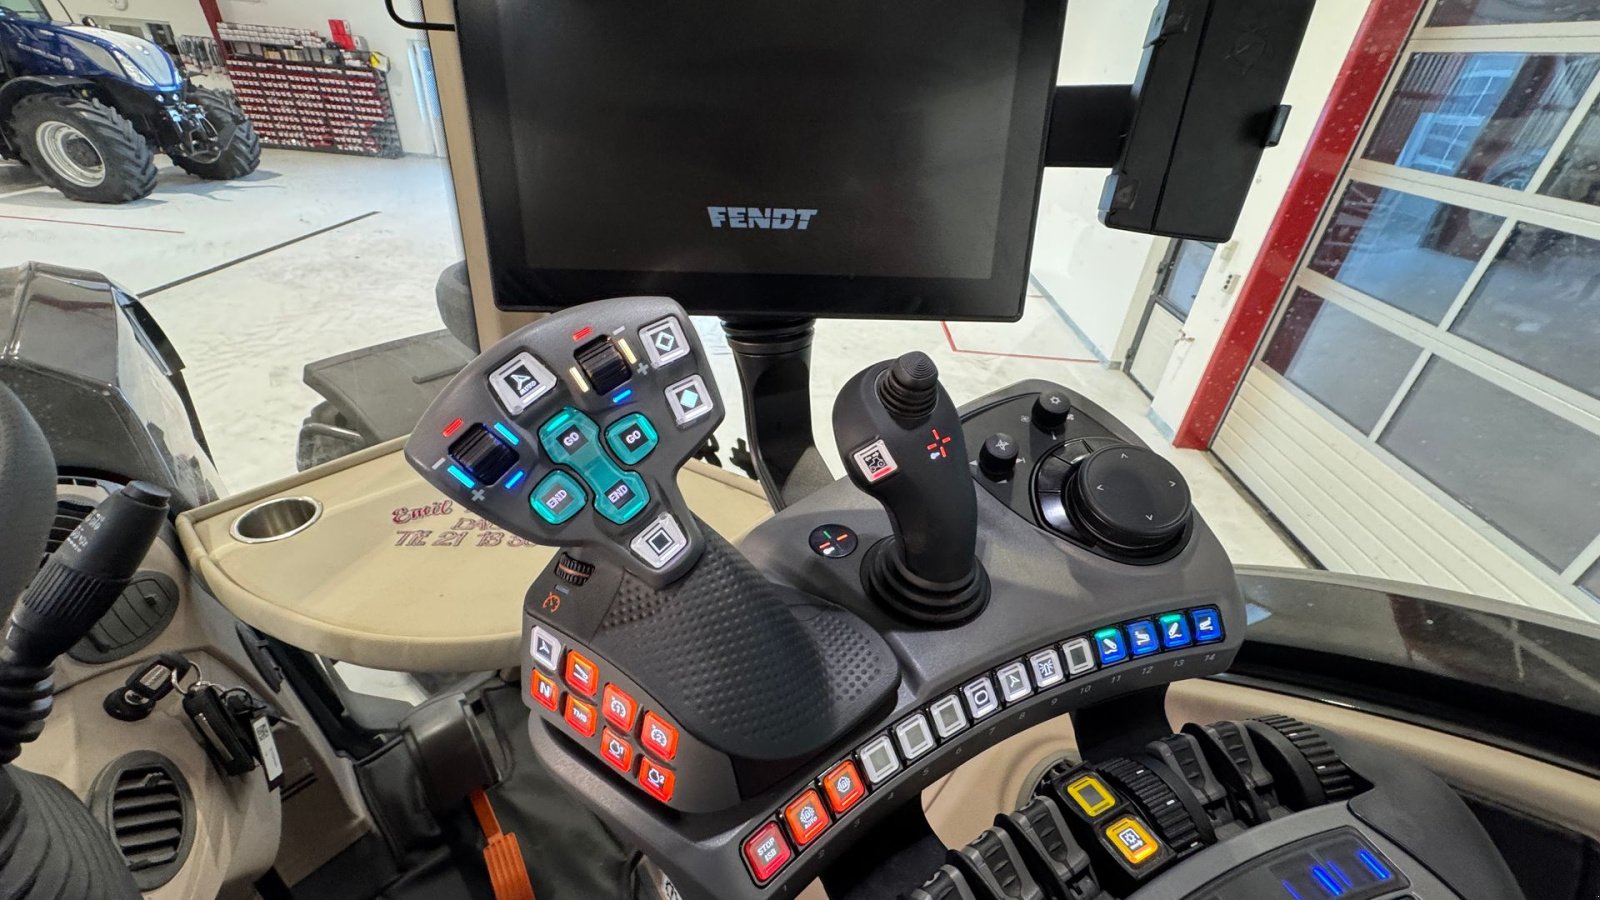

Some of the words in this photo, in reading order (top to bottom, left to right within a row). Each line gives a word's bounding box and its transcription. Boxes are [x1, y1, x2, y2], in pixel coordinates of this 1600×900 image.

[707, 206, 818, 230] FENDT
[563, 431, 580, 447] GO
[625, 430, 642, 445] GO
[546, 489, 567, 509] END
[608, 484, 629, 504] END
[1173, 659, 1185, 667] 13
[1204, 653, 1216, 662] 14
[1141, 665, 1153, 675] 12
[1111, 675, 1121, 684] 11
[539, 682, 551, 698] N
[1080, 685, 1092, 694] 10
[757, 836, 775, 856] STOP
